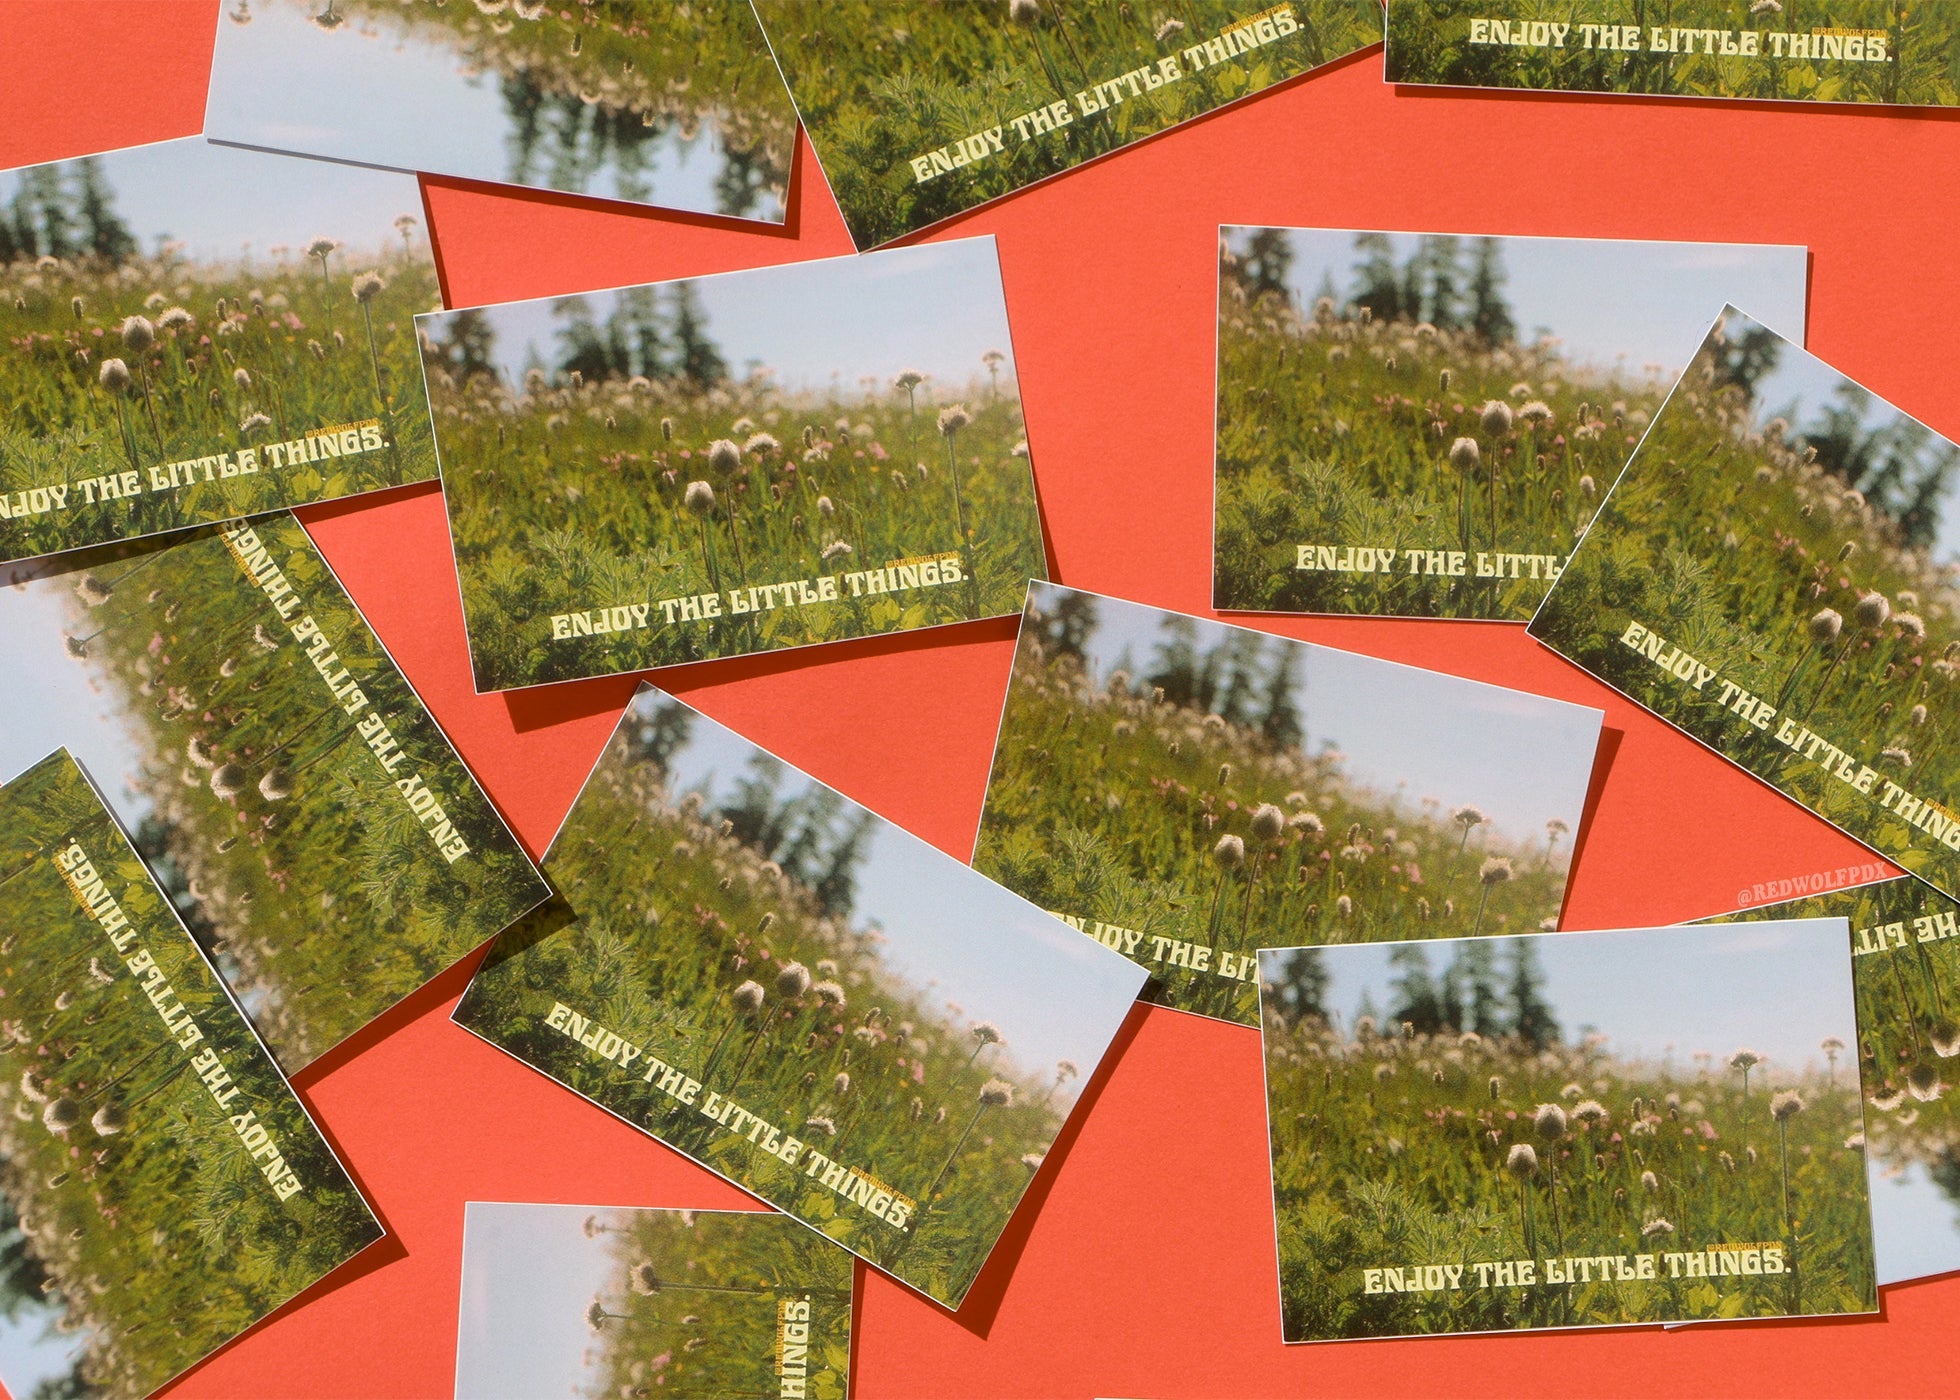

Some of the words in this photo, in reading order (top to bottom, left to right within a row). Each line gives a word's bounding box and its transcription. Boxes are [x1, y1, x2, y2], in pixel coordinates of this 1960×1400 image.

[1470, 18, 1570, 47] ENJOY
[1579, 24, 1641, 51] THE
[1650, 27, 1759, 56] LITTLE
[1769, 33, 1892, 62] THINGS.
[909, 127, 1004, 184] ENJOY
[1010, 100, 1073, 142] THE
[1075, 56, 1182, 117] LITTLE
[1184, 9, 1304, 72] THINGS.
[77, 471, 141, 504] THE
[148, 449, 258, 491] LITTLE
[265, 426, 389, 468] THINGS.
[551, 602, 650, 640] ENJOY
[658, 592, 721, 624] THE
[731, 576, 838, 614] LITTLE
[845, 558, 968, 597] THINGS.
[1296, 545, 1396, 572] ENJOY
[1405, 550, 1467, 576] THE
[1476, 552, 1571, 580] LITTL
[291, 615, 369, 716] LITTLE
[1620, 621, 1717, 691] ENJOY
[1718, 679, 1777, 731] THE
[1775, 717, 1878, 794] LITTLE
[356, 712, 406, 774] THE
[394, 774, 470, 864] ENJOY
[58, 838, 137, 952] THINGS.
[1151, 935, 1212, 972] THE
[127, 949, 204, 1051] LITTLE
[191, 1048, 241, 1110] THE
[545, 1002, 641, 1068] ENJOY
[643, 1057, 702, 1106] THE
[700, 1091, 803, 1165] LITTLE
[805, 1150, 909, 1233] THINGS.
[229, 1110, 302, 1202] ENJOY
[1363, 1264, 1463, 1294] ENJOY
[1473, 1260, 1536, 1288] THE
[1545, 1254, 1655, 1284] LITTLE
[1664, 1248, 1791, 1277] THINGS.
